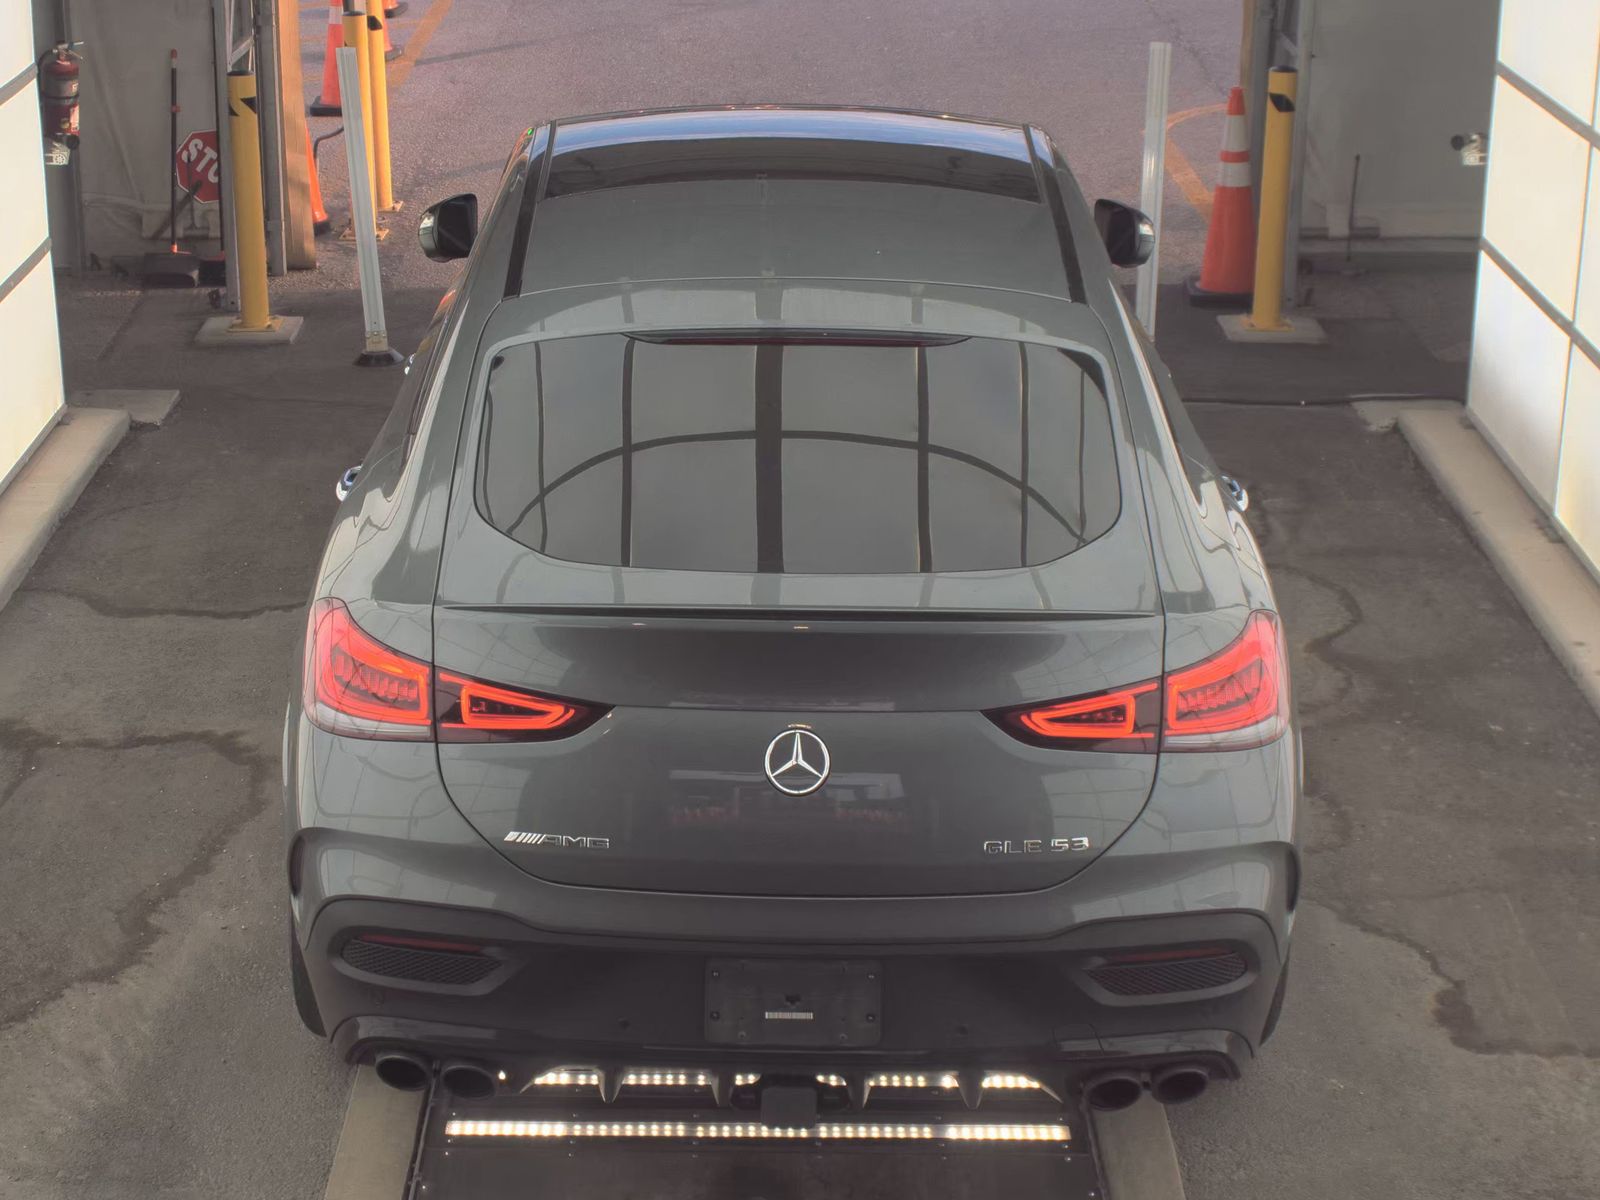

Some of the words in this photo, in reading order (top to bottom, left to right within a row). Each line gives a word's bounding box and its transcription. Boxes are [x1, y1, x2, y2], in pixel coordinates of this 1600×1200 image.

[181, 138, 219, 184] STO
[536, 833, 610, 849] AMG
[983, 839, 1043, 854] GLE
[1050, 836, 1090, 852] 53
